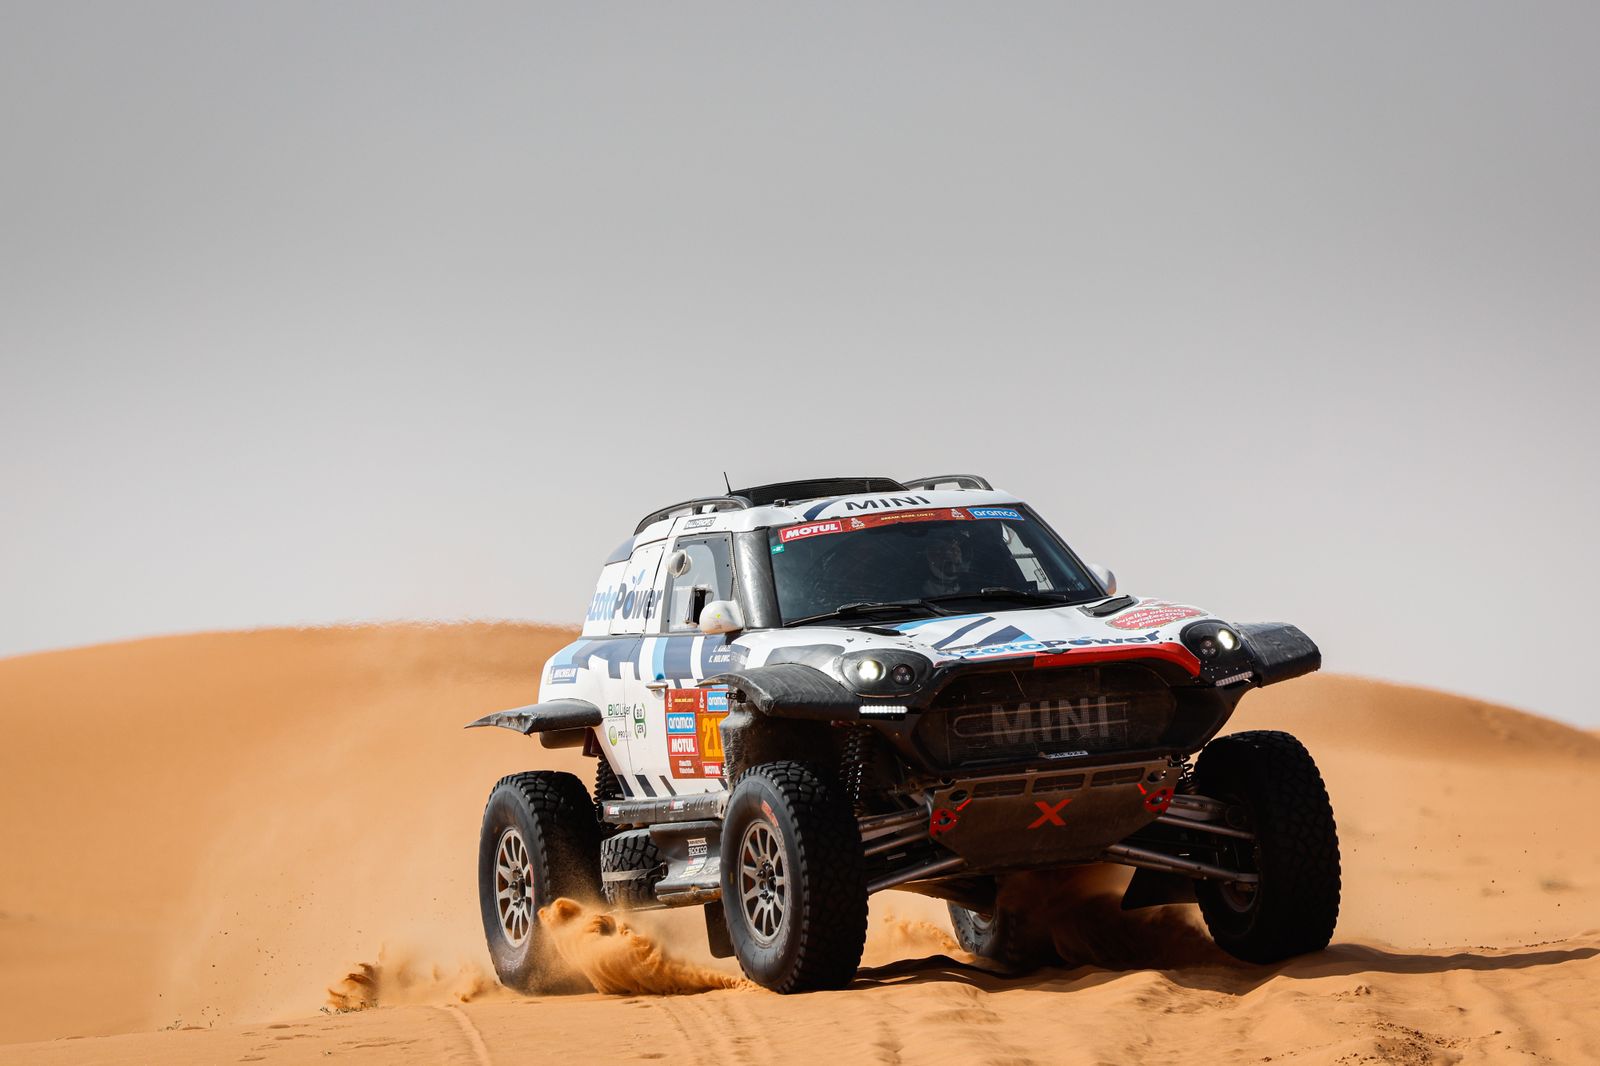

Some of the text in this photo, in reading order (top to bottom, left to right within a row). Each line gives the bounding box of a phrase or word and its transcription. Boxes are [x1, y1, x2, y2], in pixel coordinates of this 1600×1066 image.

[845, 495, 931, 511] MINI
[973, 509, 1018, 518] aramco
[785, 523, 839, 538] MOTUL
[1115, 612, 1148, 624] wielka
[668, 716, 694, 730] aramco
[990, 696, 1110, 745] MINI
[671, 738, 695, 753] MOTUL
[688, 846, 707, 856] sparco
